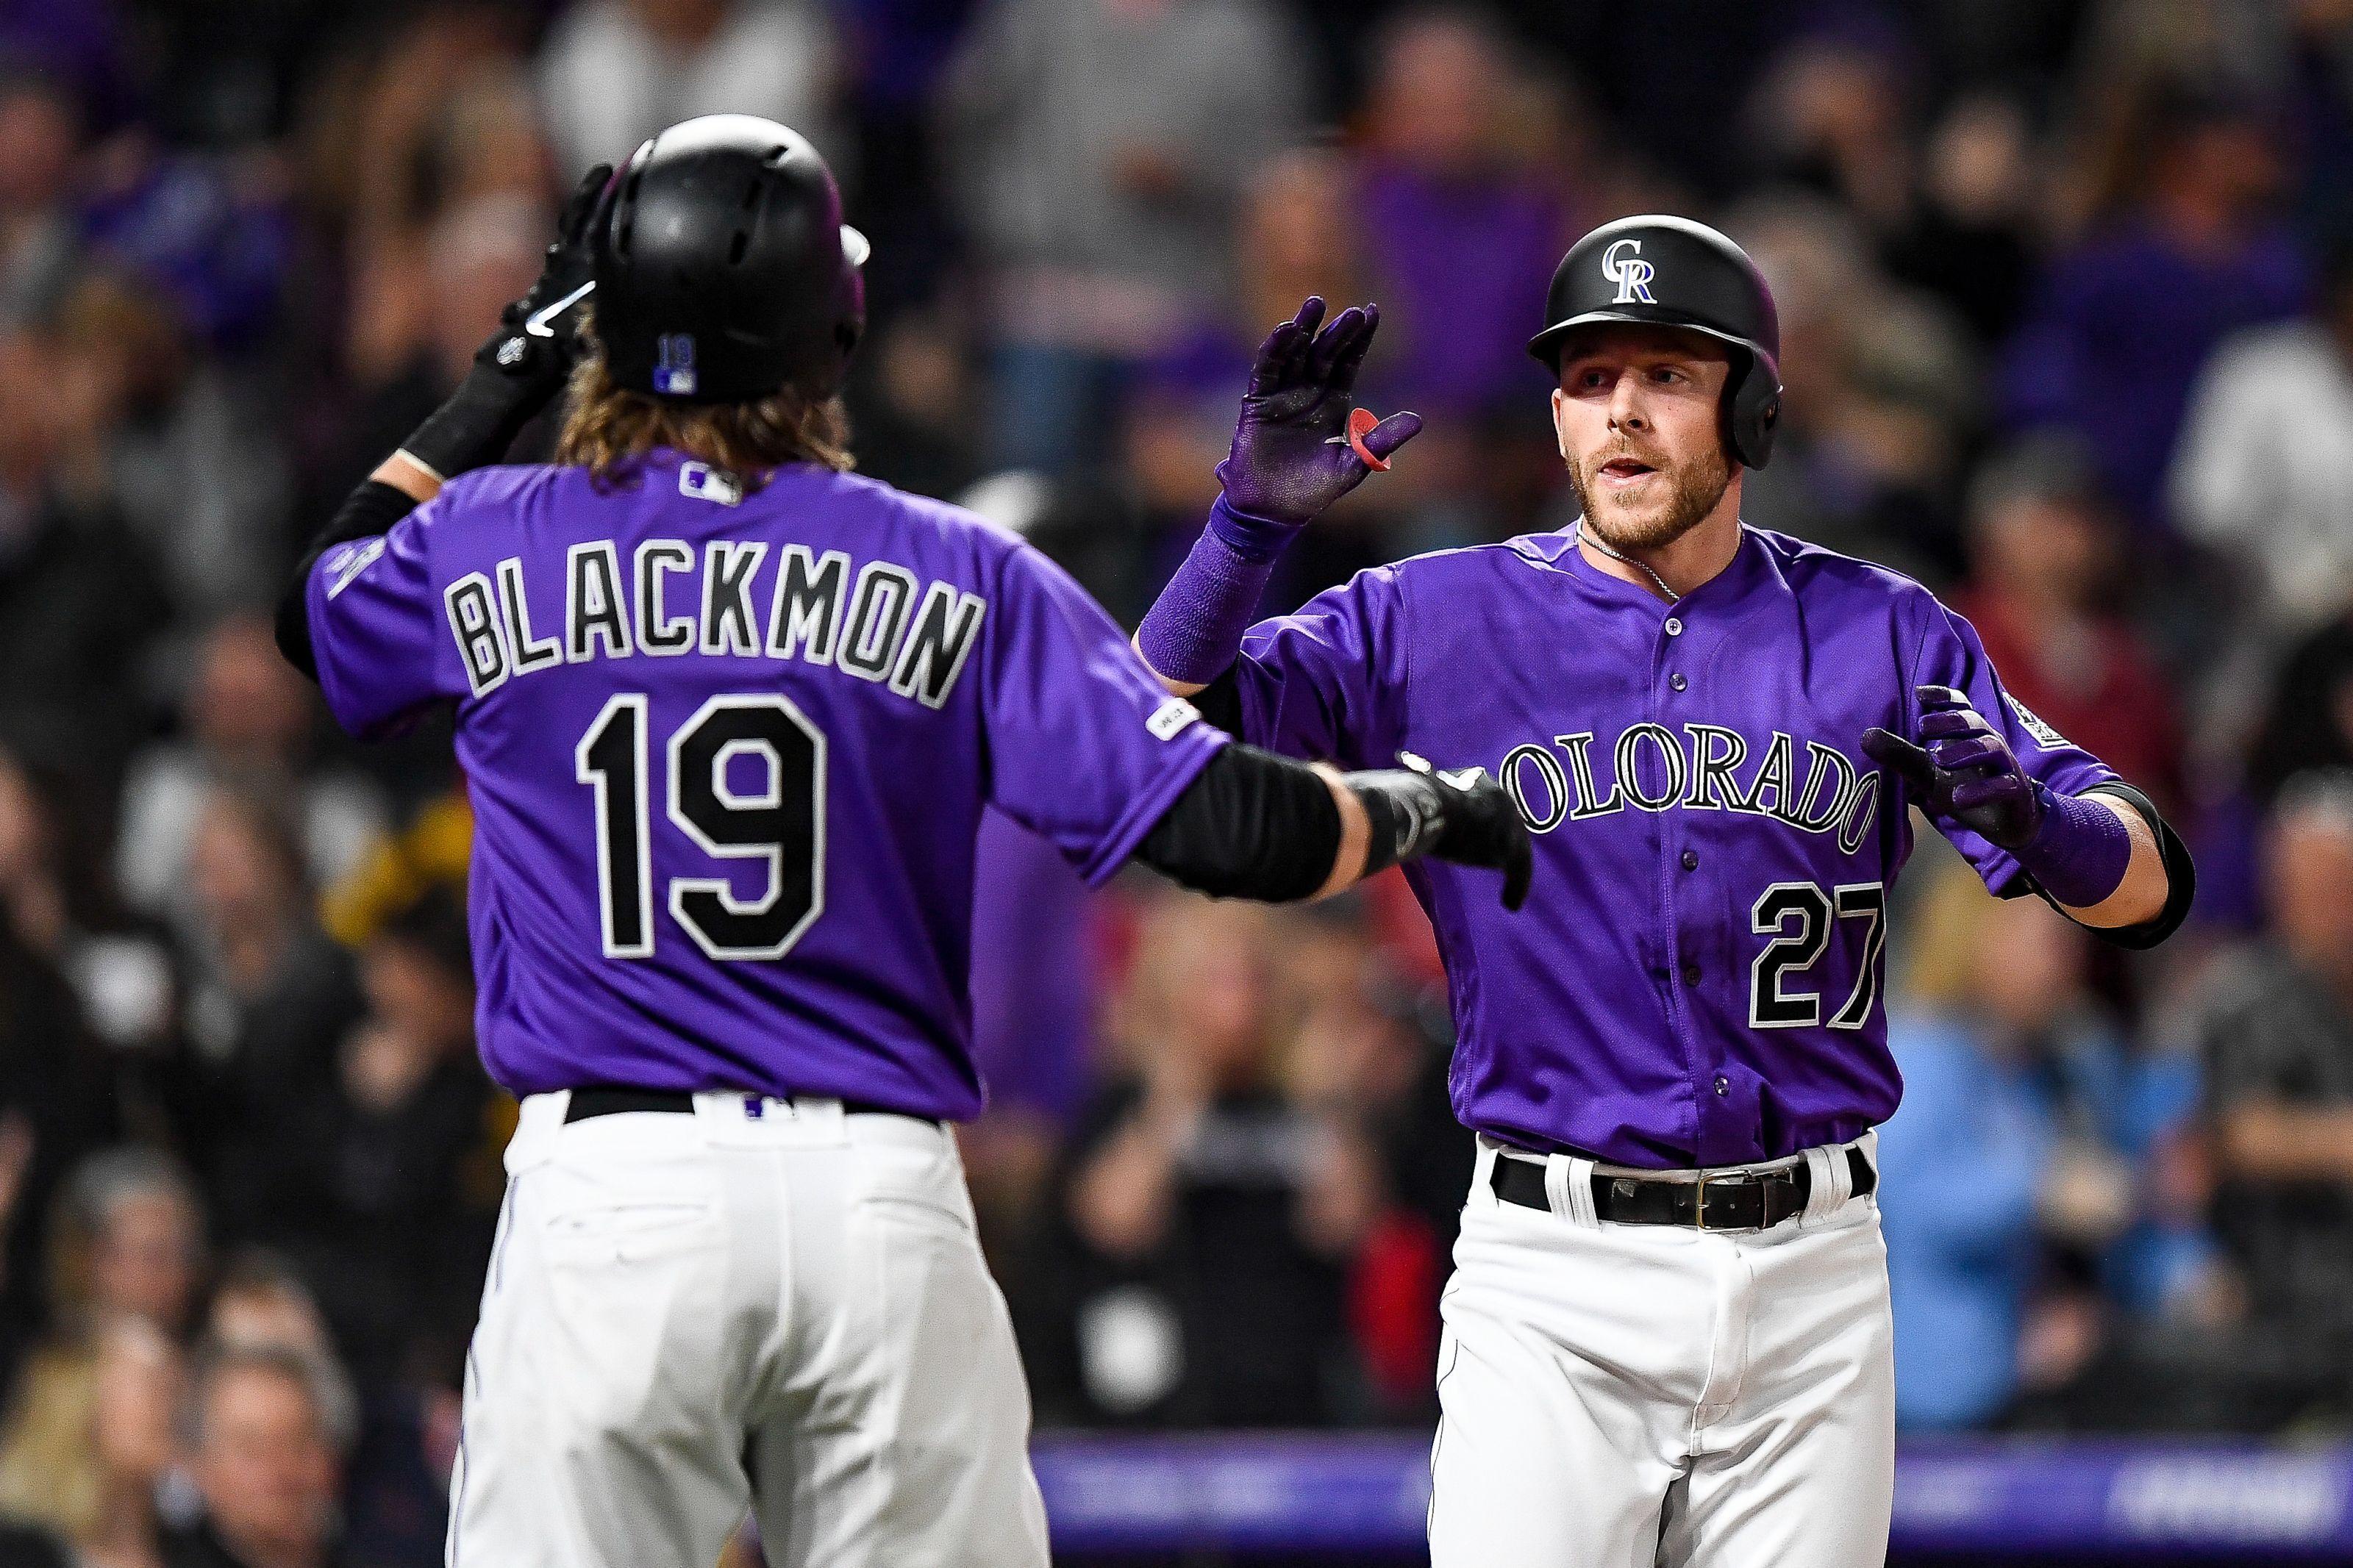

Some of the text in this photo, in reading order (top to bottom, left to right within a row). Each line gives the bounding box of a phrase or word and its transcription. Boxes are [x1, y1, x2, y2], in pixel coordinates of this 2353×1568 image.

[1602, 238, 1658, 304] CR
[443, 539, 986, 710] BLACKMON
[575, 692, 828, 960] 19
[1499, 722, 1880, 854] OLORADO
[1749, 881, 1886, 1029] 27
